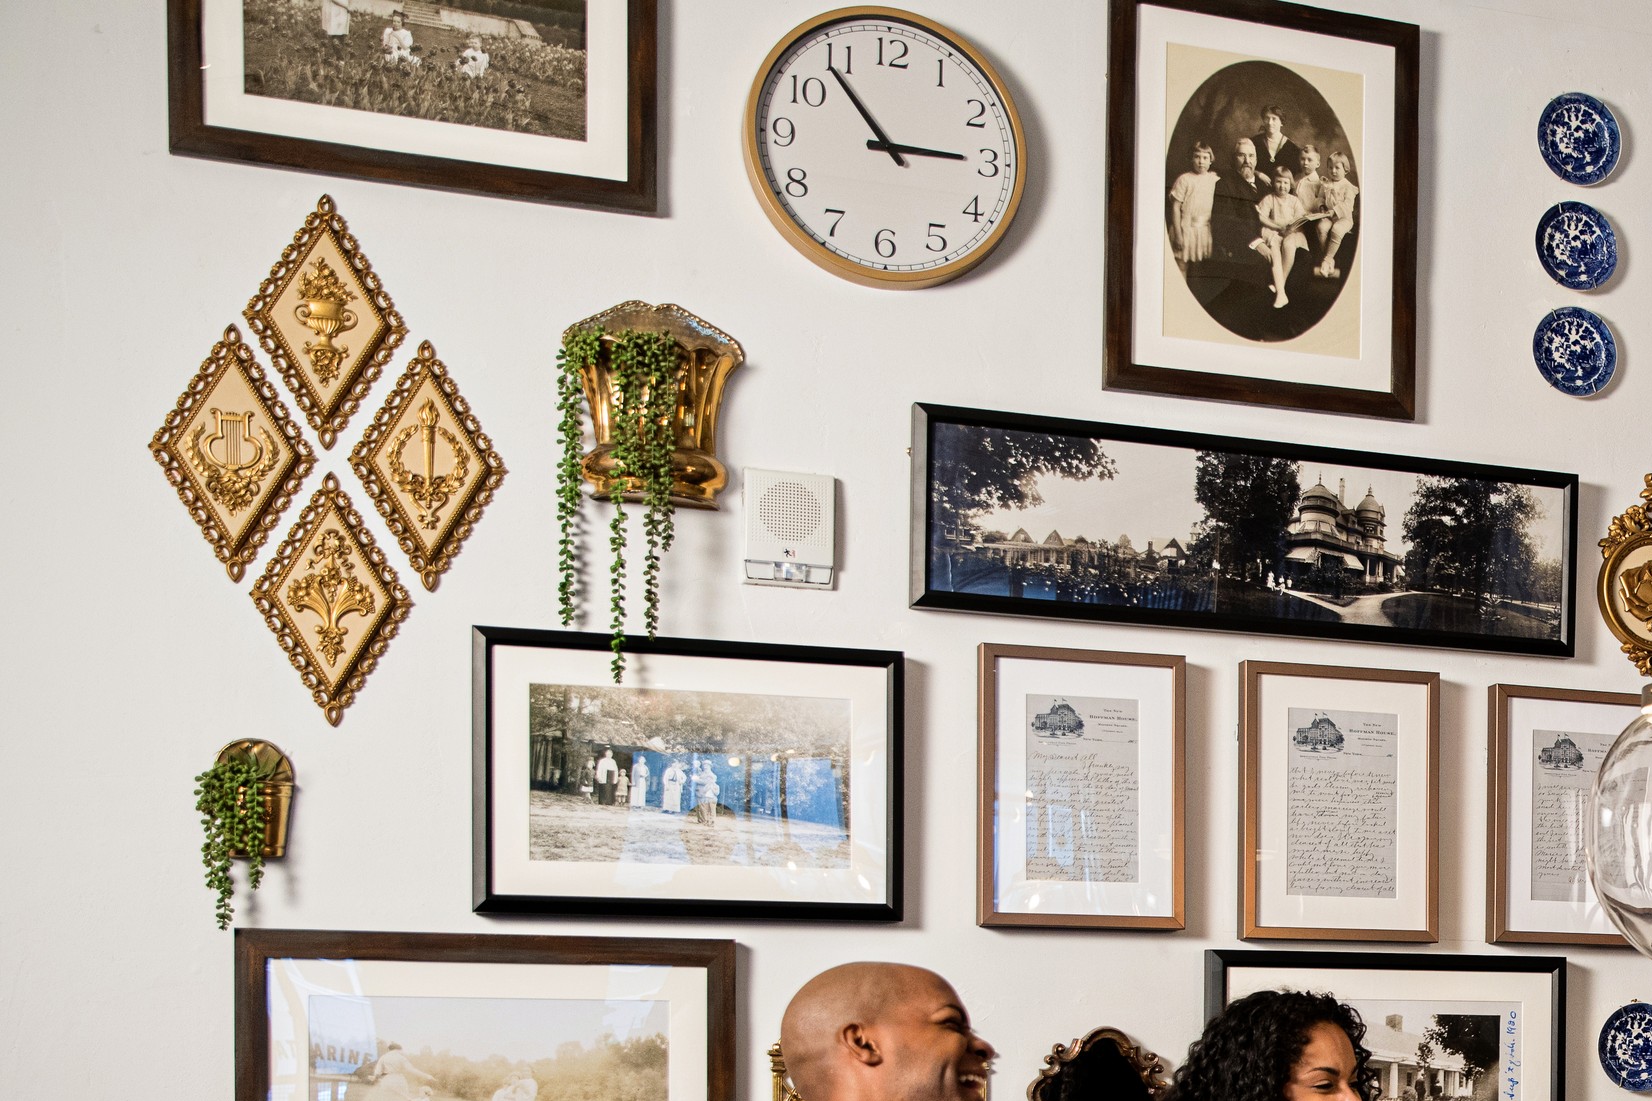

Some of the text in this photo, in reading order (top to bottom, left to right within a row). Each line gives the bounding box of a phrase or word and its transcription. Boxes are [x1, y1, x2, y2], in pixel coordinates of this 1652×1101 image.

[826, 43, 853, 74] 11
[877, 37, 909, 69] 12
[937, 59, 945, 87] 1
[790, 75, 826, 107] 10
[966, 100, 986, 128] 2
[772, 117, 795, 147] 9
[977, 149, 998, 177] 3
[785, 168, 808, 197] 8
[824, 208, 845, 236] 7
[962, 195, 984, 222] 4
[874, 229, 896, 258] 6
[926, 223, 947, 251] 5
